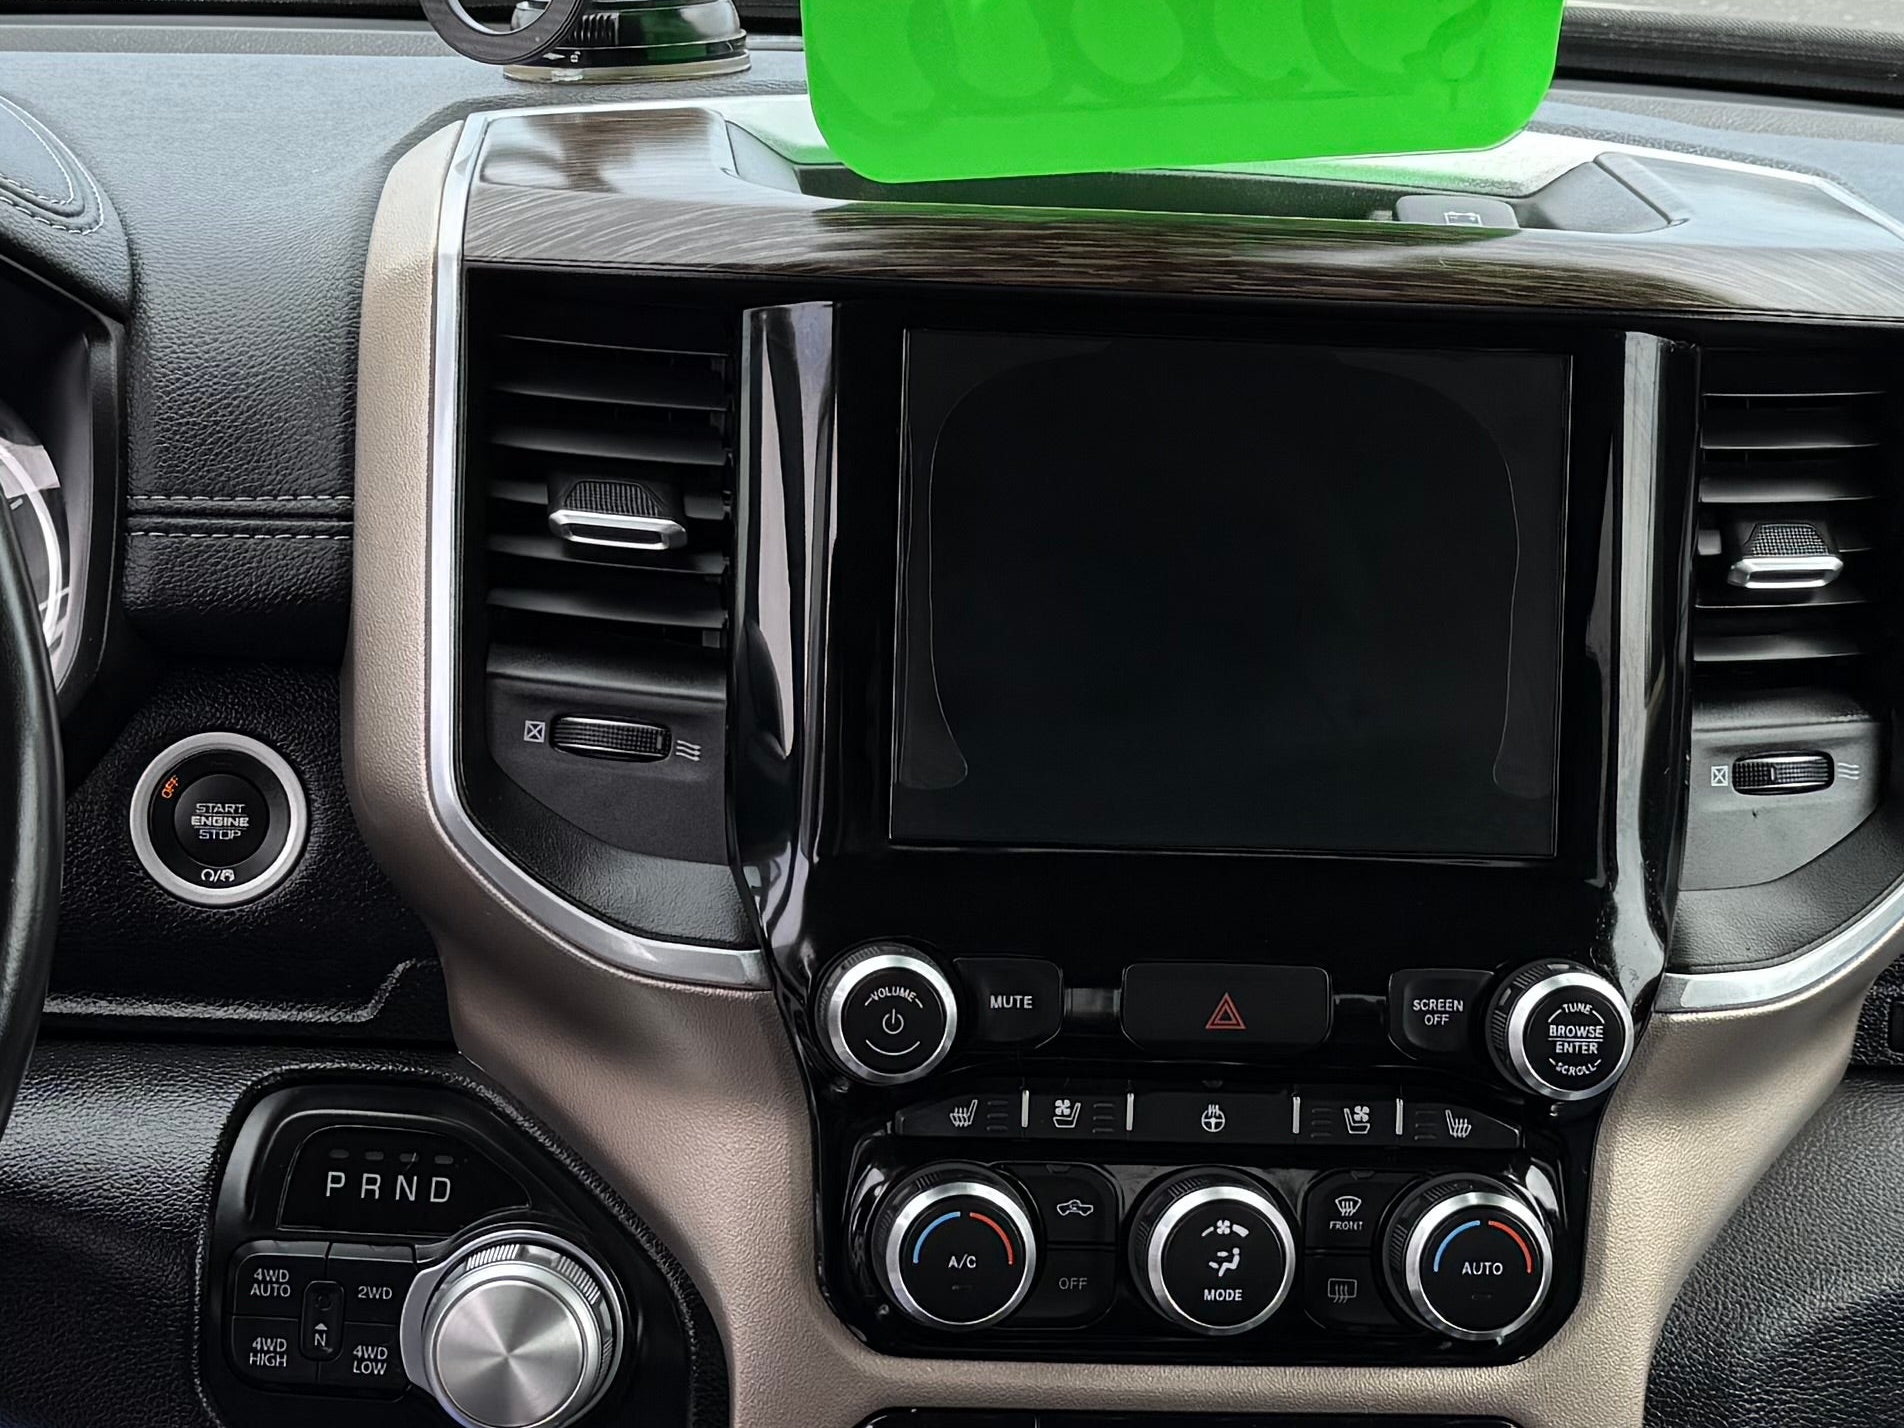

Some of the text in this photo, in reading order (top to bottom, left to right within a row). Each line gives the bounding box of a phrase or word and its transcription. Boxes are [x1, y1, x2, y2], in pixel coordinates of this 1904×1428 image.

[195, 803, 246, 814] START
[191, 815, 250, 827] ENGINE
[198, 828, 242, 840] STOP
[869, 985, 918, 1003] VOLUME
[989, 995, 1034, 1010] MUTE
[1412, 999, 1465, 1012] SCREEN
[1561, 1002, 1594, 1015] TUNE
[1424, 1014, 1450, 1026] OFF
[1548, 1024, 1605, 1039] BROWSE
[1555, 1041, 1599, 1055] ENTER
[1555, 1061, 1598, 1077] SCROLL
[326, 1172, 452, 1204] P R N D
[1328, 1220, 1364, 1233] FRONT
[947, 1253, 978, 1271] A/C
[1461, 1260, 1505, 1278] AUTO
[253, 1268, 290, 1284] 4WD
[1057, 1276, 1089, 1292] OFF
[250, 1283, 291, 1299] AUTO
[357, 1285, 393, 1302] 2WD
[1203, 1287, 1244, 1302] MODE
[251, 1337, 288, 1352] 4WD
[314, 1332, 327, 1349] N
[249, 1351, 288, 1368] HIGH
[352, 1345, 389, 1361] 4WD
[352, 1360, 388, 1376] LOW
